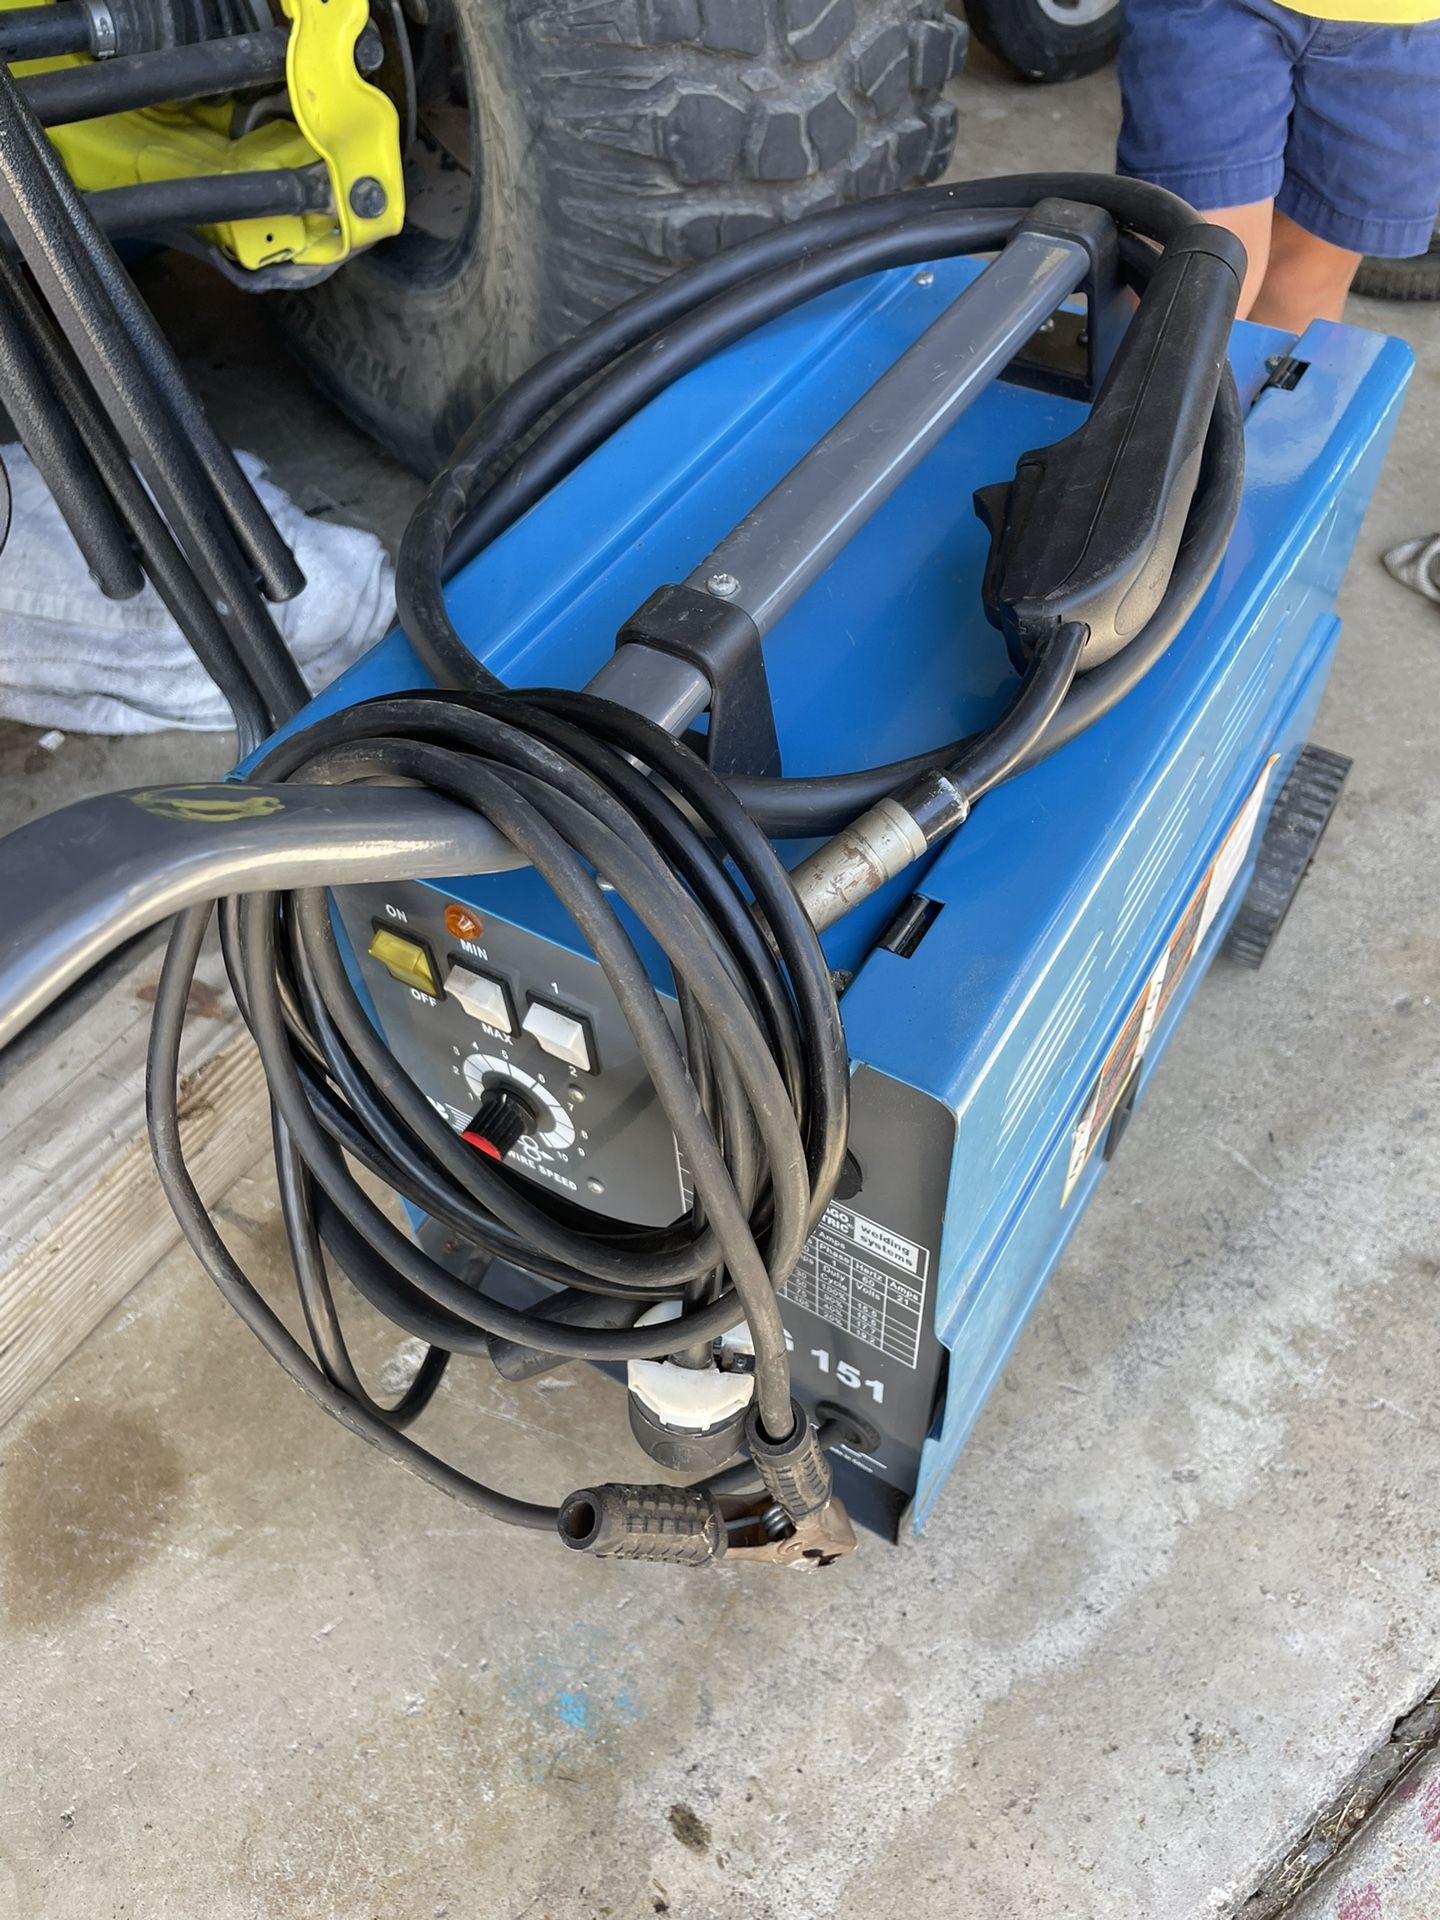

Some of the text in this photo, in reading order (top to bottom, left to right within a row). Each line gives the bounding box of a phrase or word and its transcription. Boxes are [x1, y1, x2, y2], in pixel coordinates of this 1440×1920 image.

[385, 904, 408, 923] ON
[460, 938, 488, 961] MIN
[551, 982, 559, 994] 1
[410, 988, 437, 1007] OFF
[481, 1022, 514, 1046] MAX
[452, 1046, 460, 1056] 3
[501, 1050, 509, 1060] 5
[452, 1065, 460, 1075] 2
[538, 1073, 546, 1083] 6
[568, 1065, 578, 1077] 2
[468, 1092, 474, 1101] 1
[567, 1102, 574, 1112] 7
[556, 1150, 569, 1162] 10
[577, 1147, 586, 1157] 9
[538, 1165, 578, 1191] SPEED
[819, 1231, 846, 1250] Amps
[860, 1225, 910, 1257] welding
[819, 1243, 850, 1264] Phase
[860, 1235, 913, 1267] systems
[823, 1265, 846, 1282] Duty
[855, 1262, 883, 1282] Hertz
[820, 1273, 848, 1292] Cycle
[855, 1281, 881, 1301] Volts
[862, 1276, 875, 1288] 60
[889, 1281, 919, 1301] Amps
[822, 1283, 847, 1301] 100%
[896, 1294, 909, 1306] 21
[810, 1349, 885, 1404] 151
